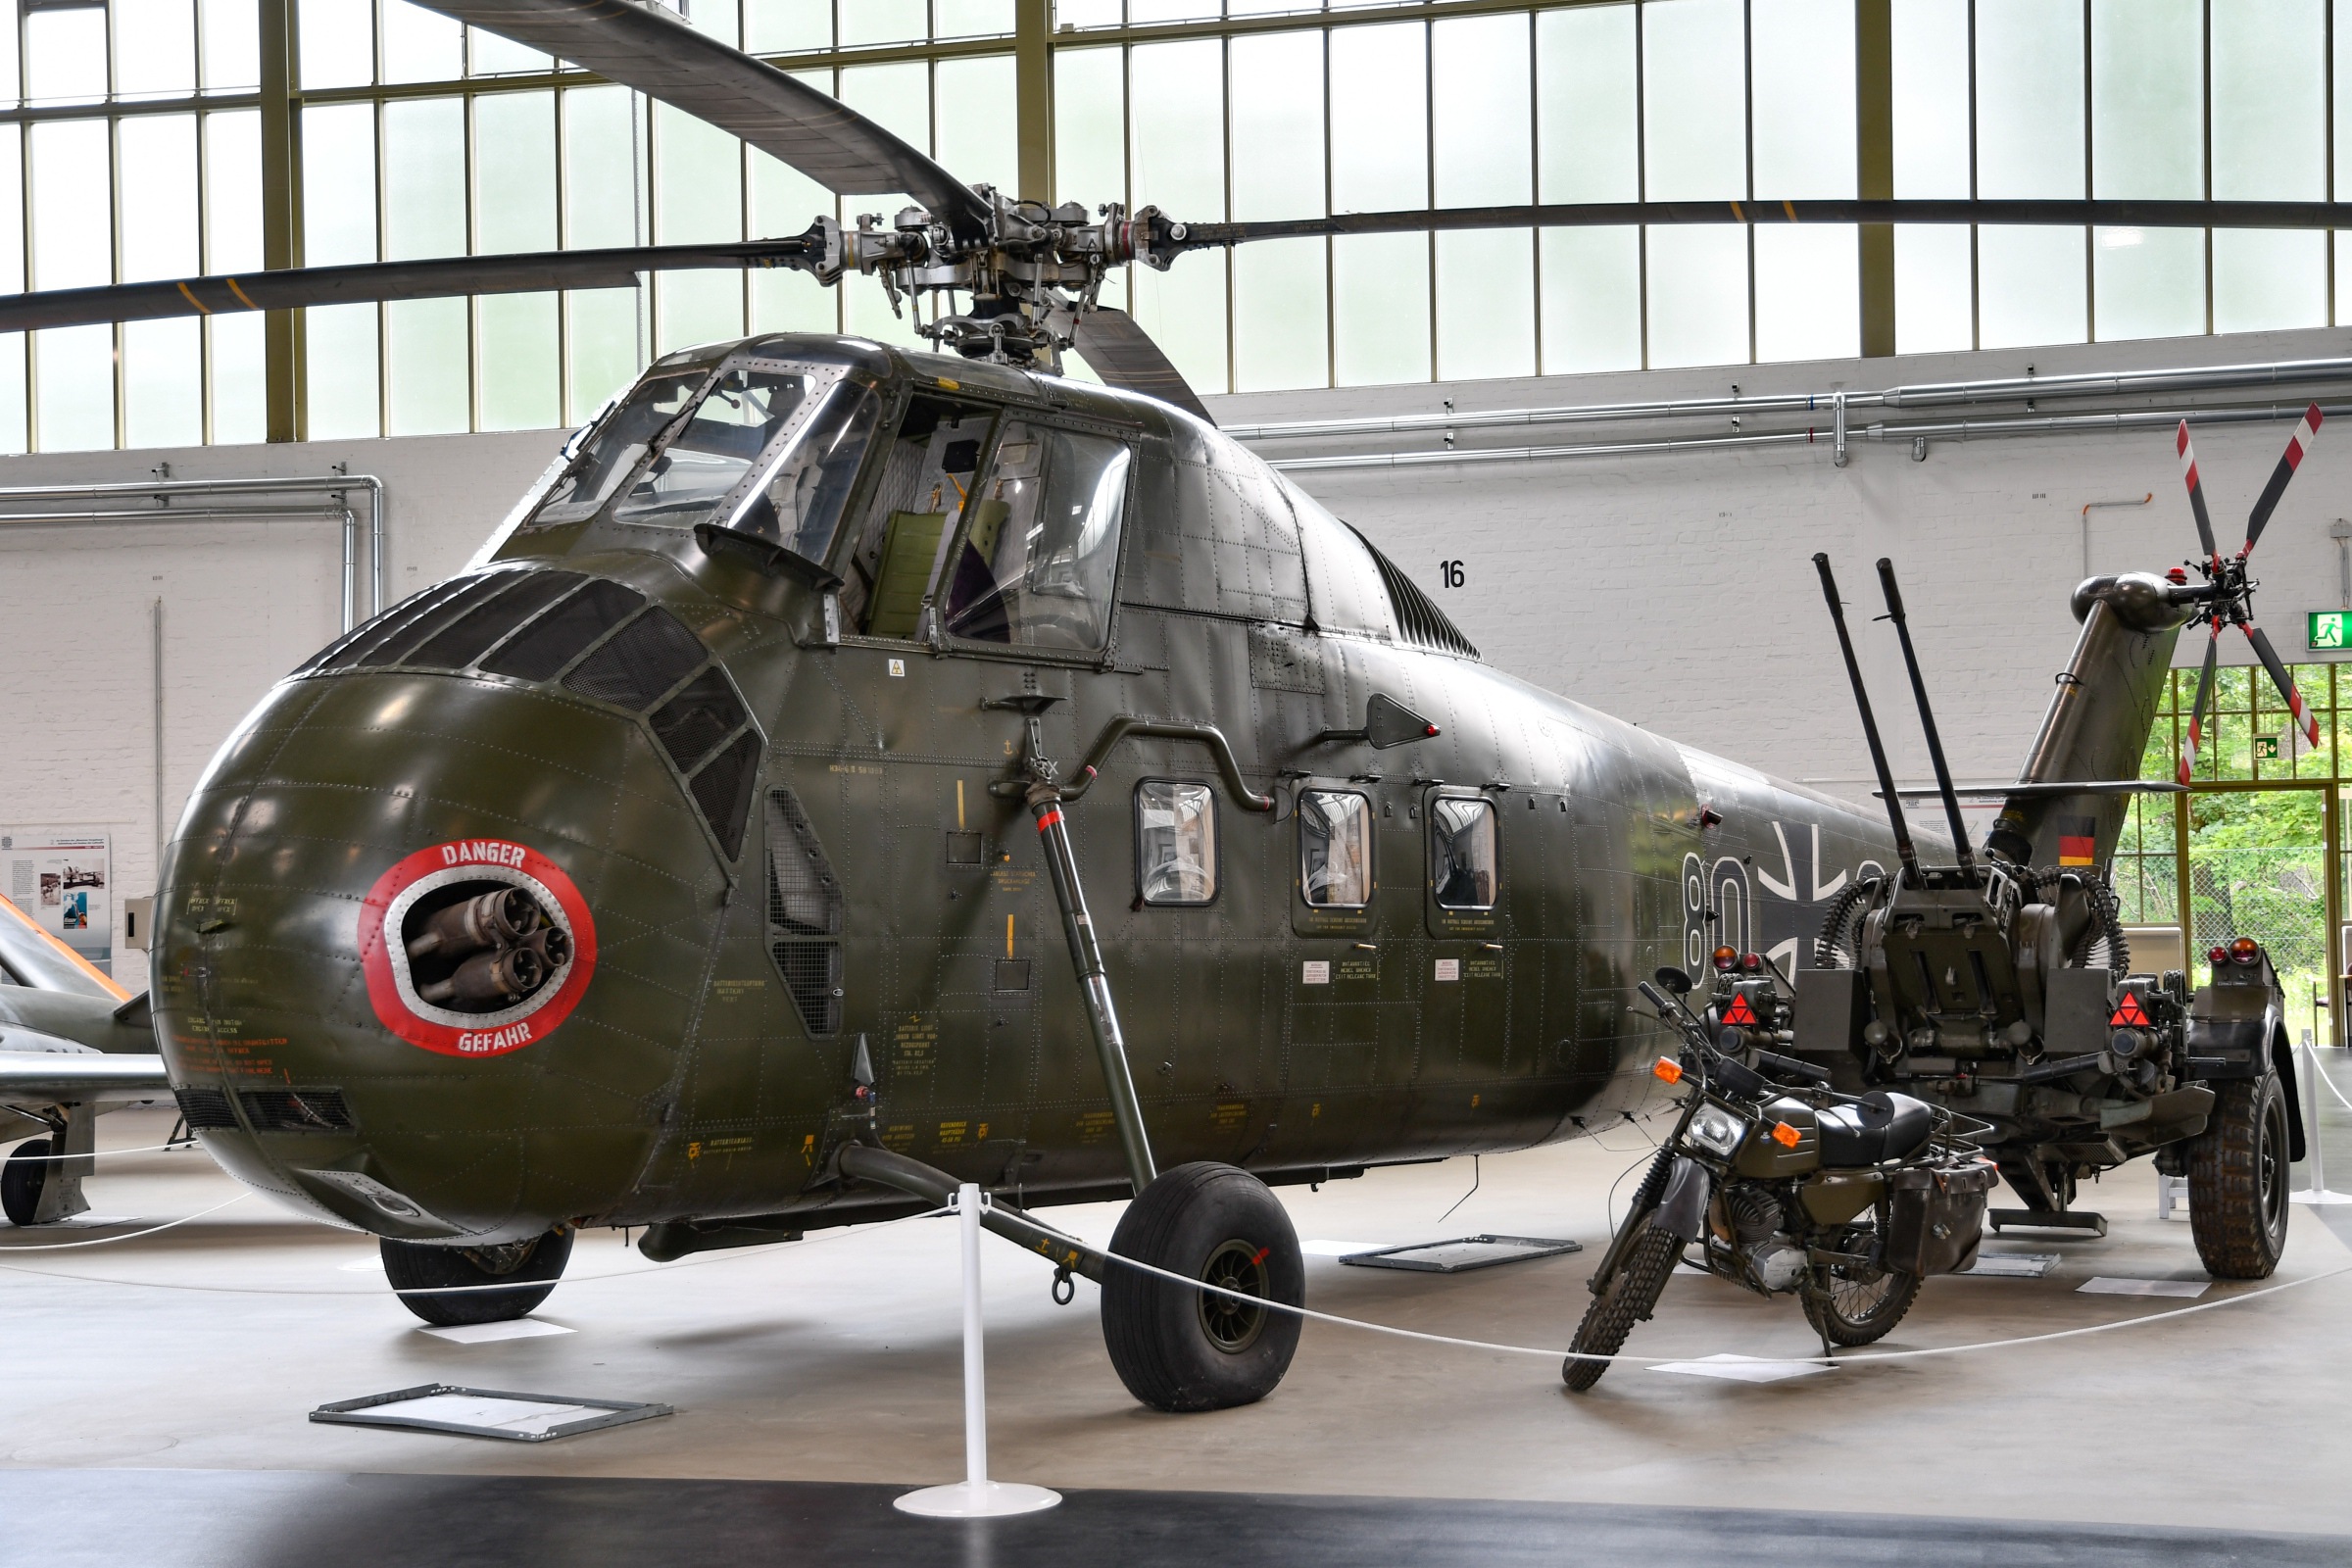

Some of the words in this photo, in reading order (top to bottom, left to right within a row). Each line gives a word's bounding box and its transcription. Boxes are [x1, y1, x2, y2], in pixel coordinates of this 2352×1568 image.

[1440, 560, 1465, 589] 16
[441, 841, 526, 868] DANGER
[459, 1022, 532, 1052] GEFAHR
